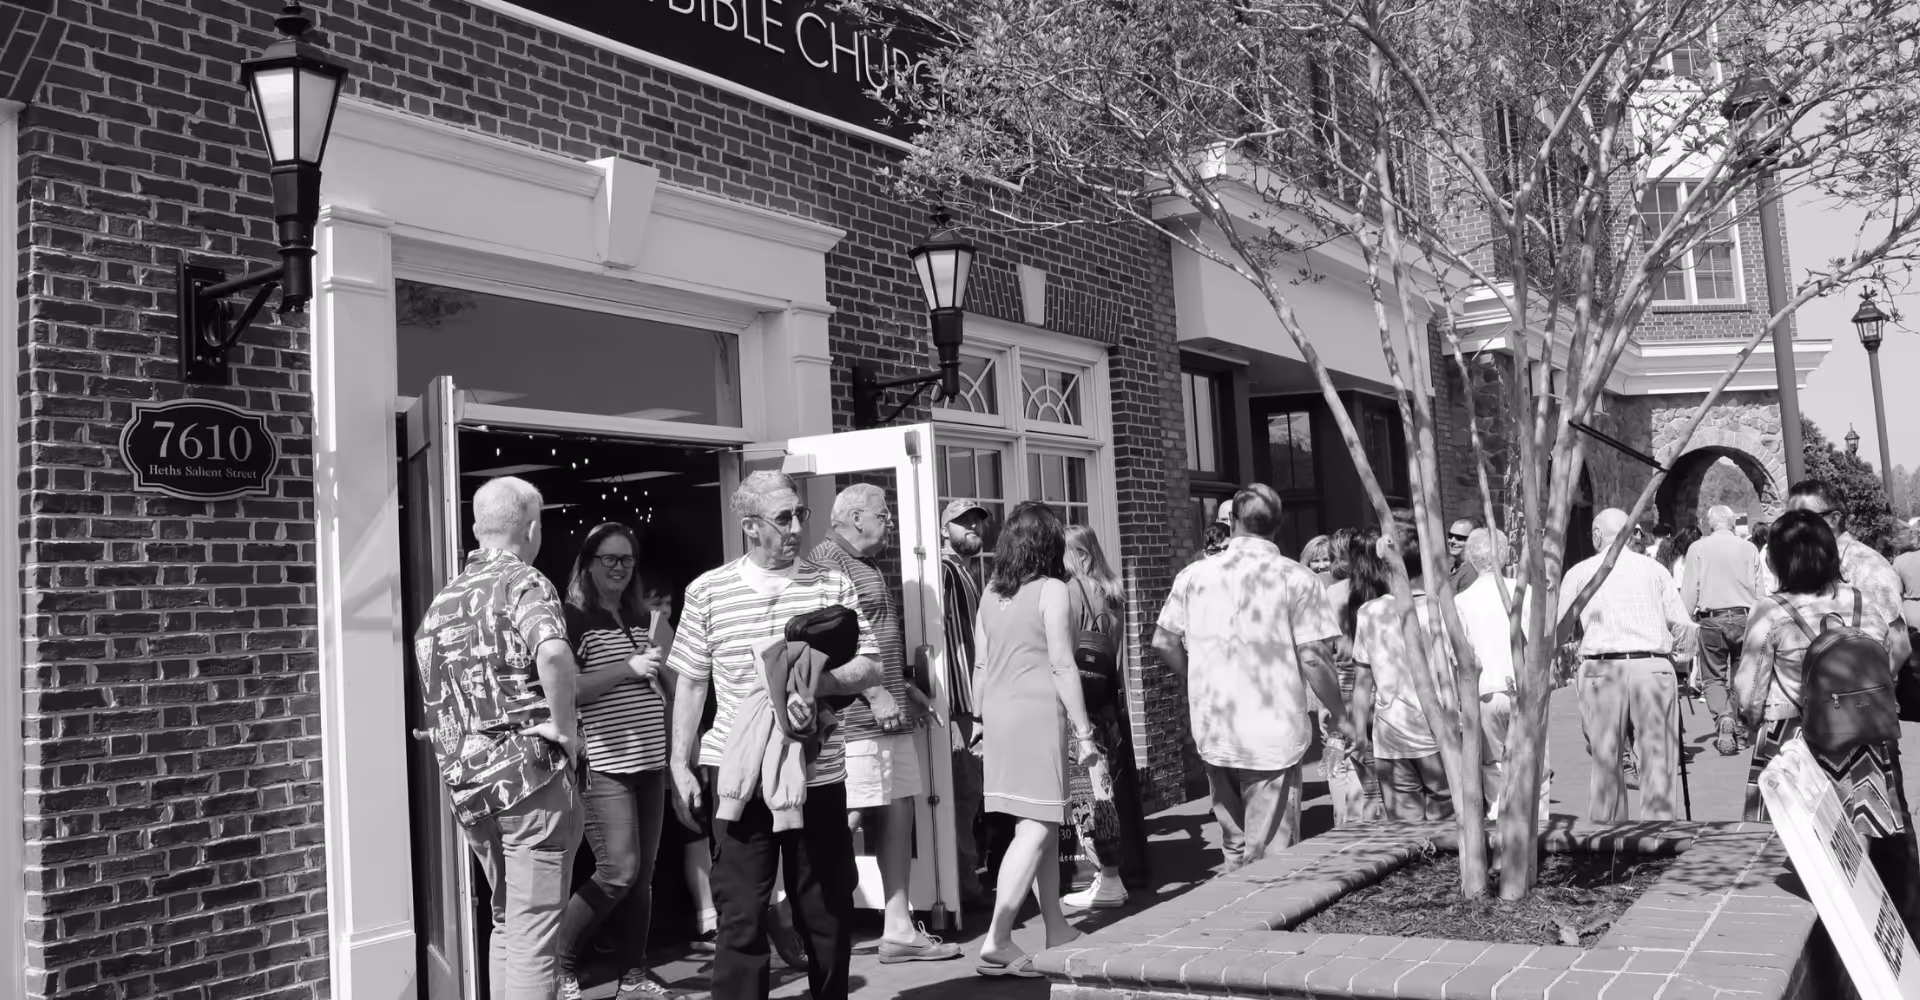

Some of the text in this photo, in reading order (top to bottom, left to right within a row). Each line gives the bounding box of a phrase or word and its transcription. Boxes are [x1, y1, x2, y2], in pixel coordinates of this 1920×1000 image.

[668, 0, 946, 111] BLE CHURC
[149, 464, 257, 479] Heths Salient Street
[152, 420, 252, 462] 7610
[1830, 811, 1863, 889] PARKING
[1874, 889, 1905, 983] RESERVED
